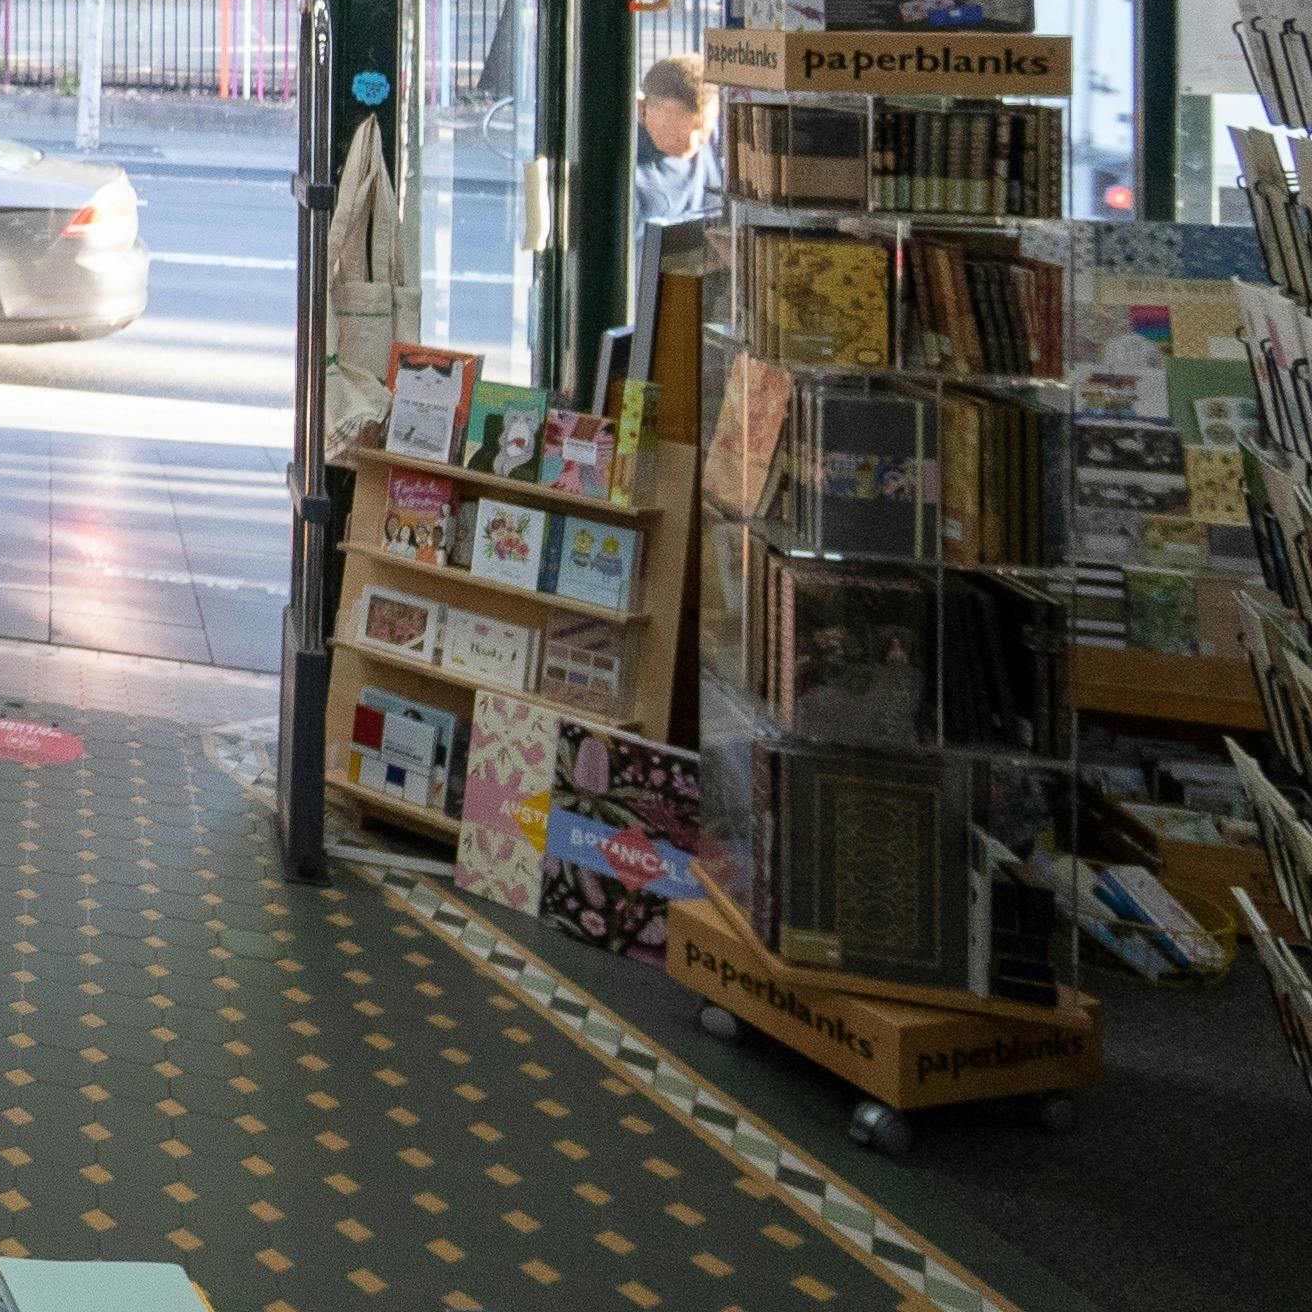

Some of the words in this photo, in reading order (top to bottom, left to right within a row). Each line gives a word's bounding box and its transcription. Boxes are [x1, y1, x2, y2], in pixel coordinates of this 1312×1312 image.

[708, 38, 778, 70] paperblanks
[802, 46, 1050, 80] paperblanks
[685, 938, 876, 1062] paperblanks
[917, 1033, 1085, 1083] paperblanks
